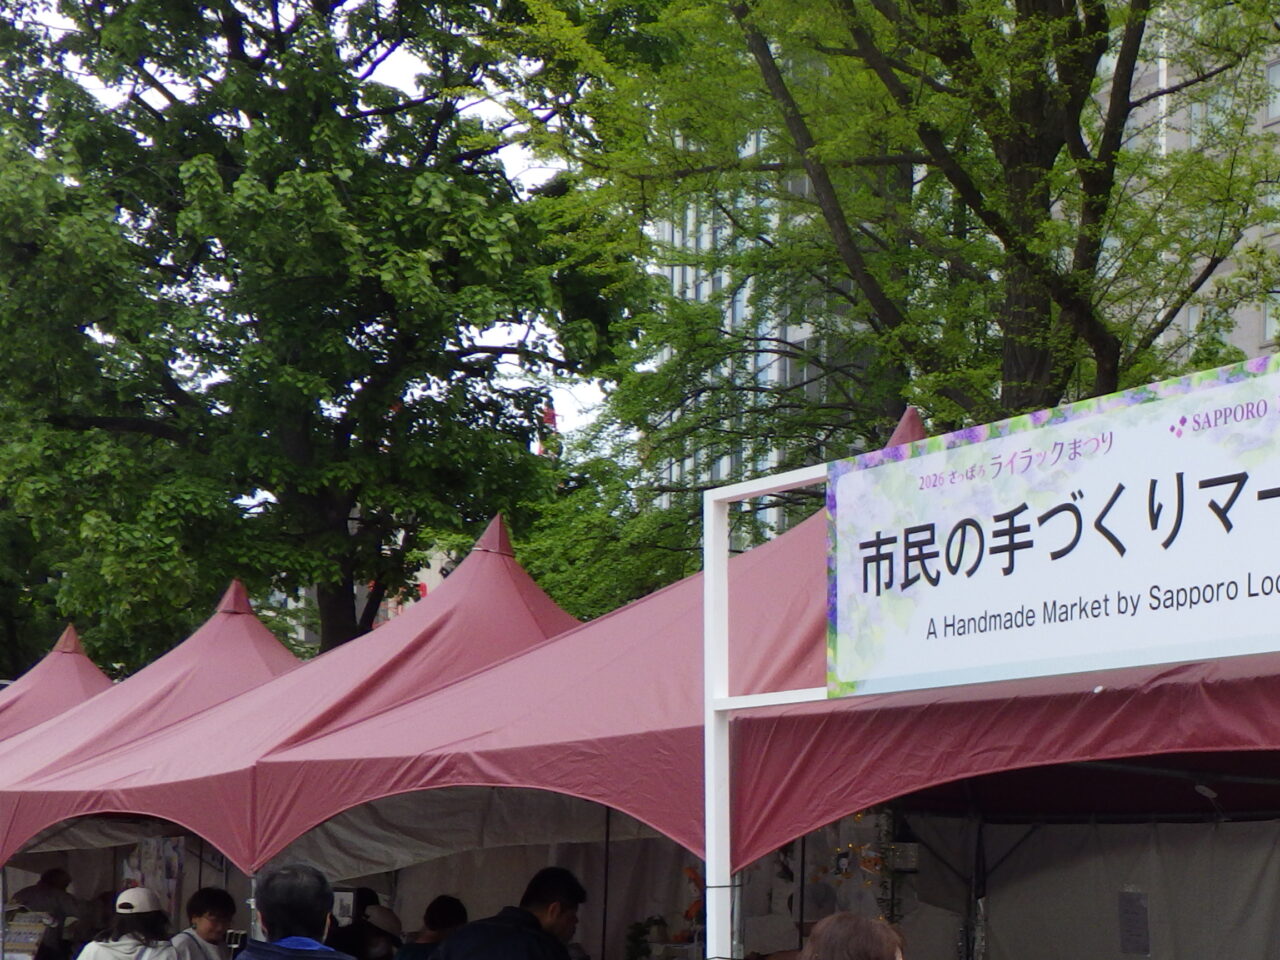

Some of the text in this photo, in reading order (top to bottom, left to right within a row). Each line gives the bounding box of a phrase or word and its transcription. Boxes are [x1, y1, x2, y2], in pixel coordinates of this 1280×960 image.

[1192, 398, 1268, 432] SAPPORO
[918, 471, 945, 491] 2026
[926, 617, 937, 640] A
[943, 604, 1036, 638] Handmade
[1043, 593, 1110, 625] Market
[1117, 591, 1141, 616] by
[1149, 580, 1238, 611] Sapporo
